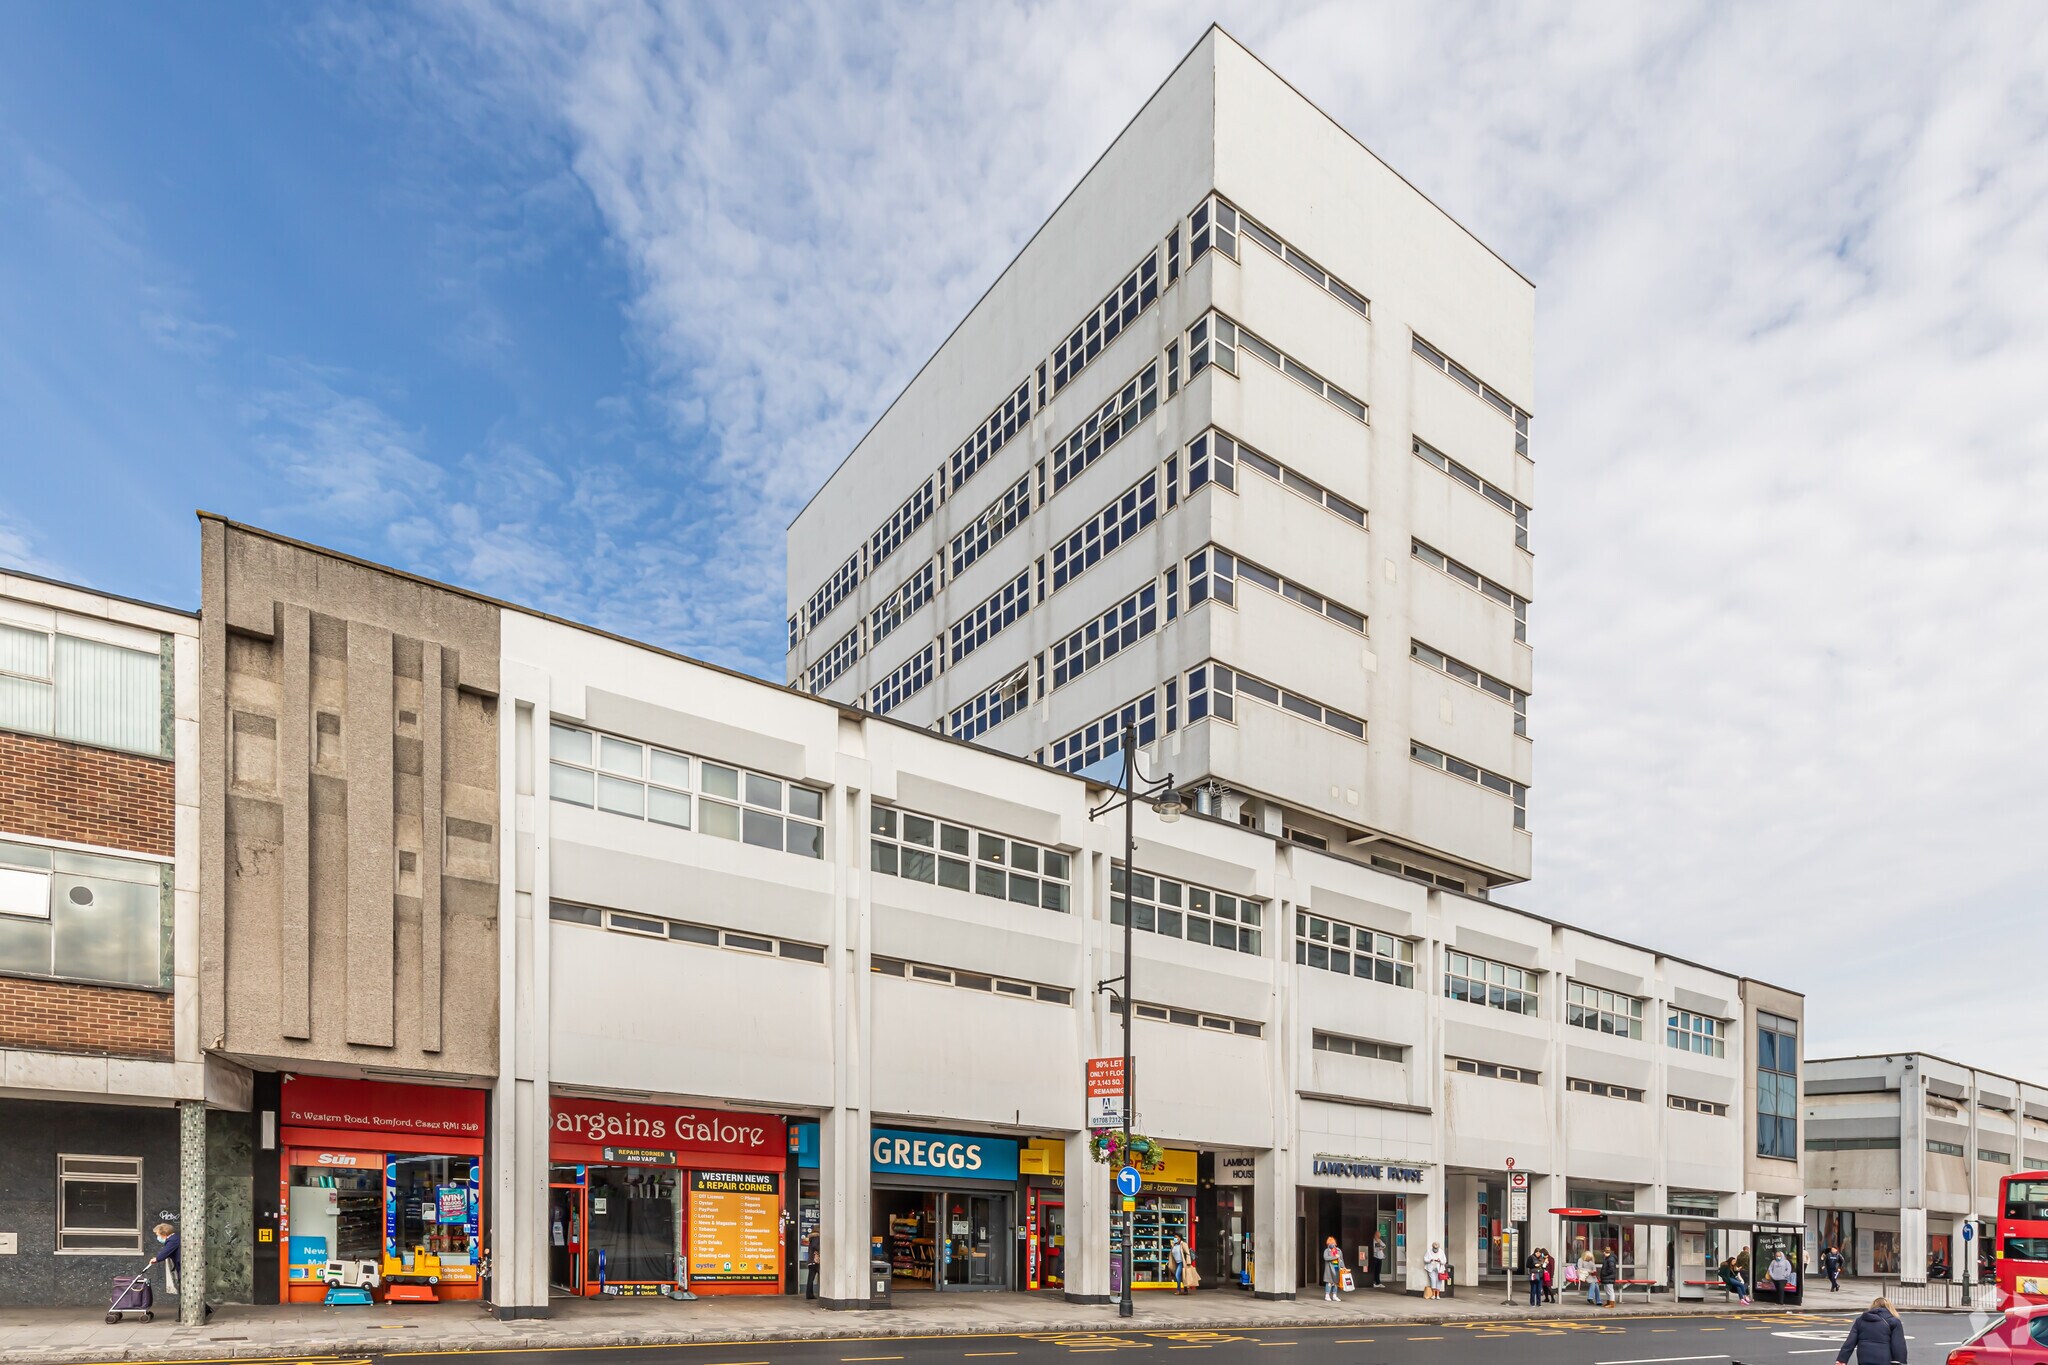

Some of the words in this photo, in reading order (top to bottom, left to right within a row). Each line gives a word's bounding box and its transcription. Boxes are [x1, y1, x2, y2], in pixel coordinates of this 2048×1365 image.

[303, 1112, 342, 1122] Western
[415, 1119, 441, 1129] Essex
[675, 1115, 765, 1147] Galore
[318, 1153, 357, 1165] Sun
[873, 1137, 982, 1170] GREGGS
[701, 1172, 744, 1182] WESTERN
[745, 1175, 770, 1184] NEWS
[1313, 1160, 1384, 1181] LAMBOURNE
[1387, 1166, 1424, 1183] HOUSE
[698, 1181, 705, 1189] &
[706, 1182, 737, 1190] REPAIR
[739, 1183, 773, 1192] CORNER
[443, 1194, 461, 1202] WIN
